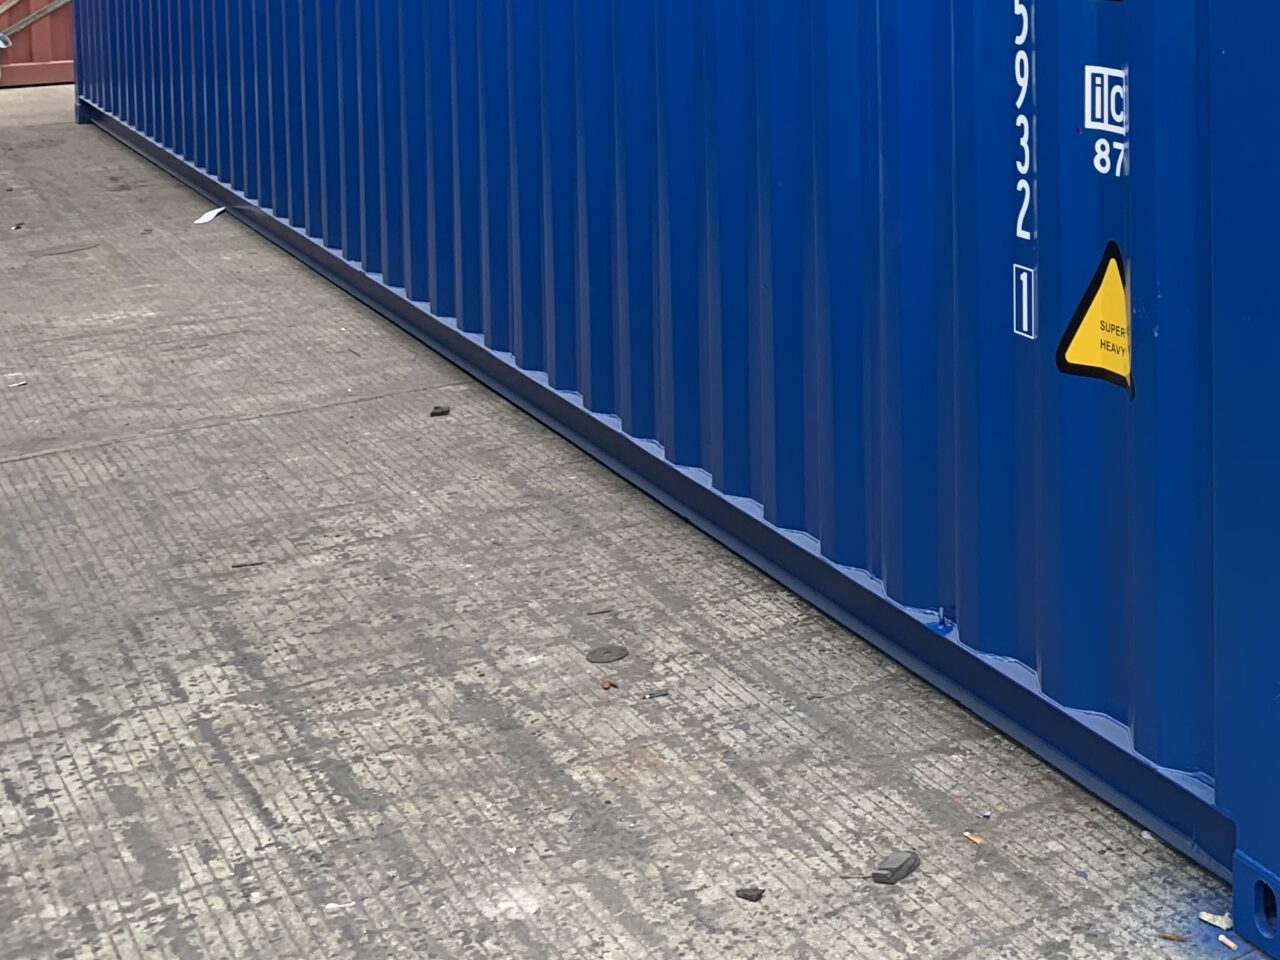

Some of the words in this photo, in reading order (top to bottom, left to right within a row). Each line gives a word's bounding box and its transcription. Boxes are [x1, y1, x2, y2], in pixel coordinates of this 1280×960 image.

[1093, 138, 1129, 177] 87
[1100, 320, 1127, 338] SUPER
[1100, 338, 1126, 356] HEAVY
